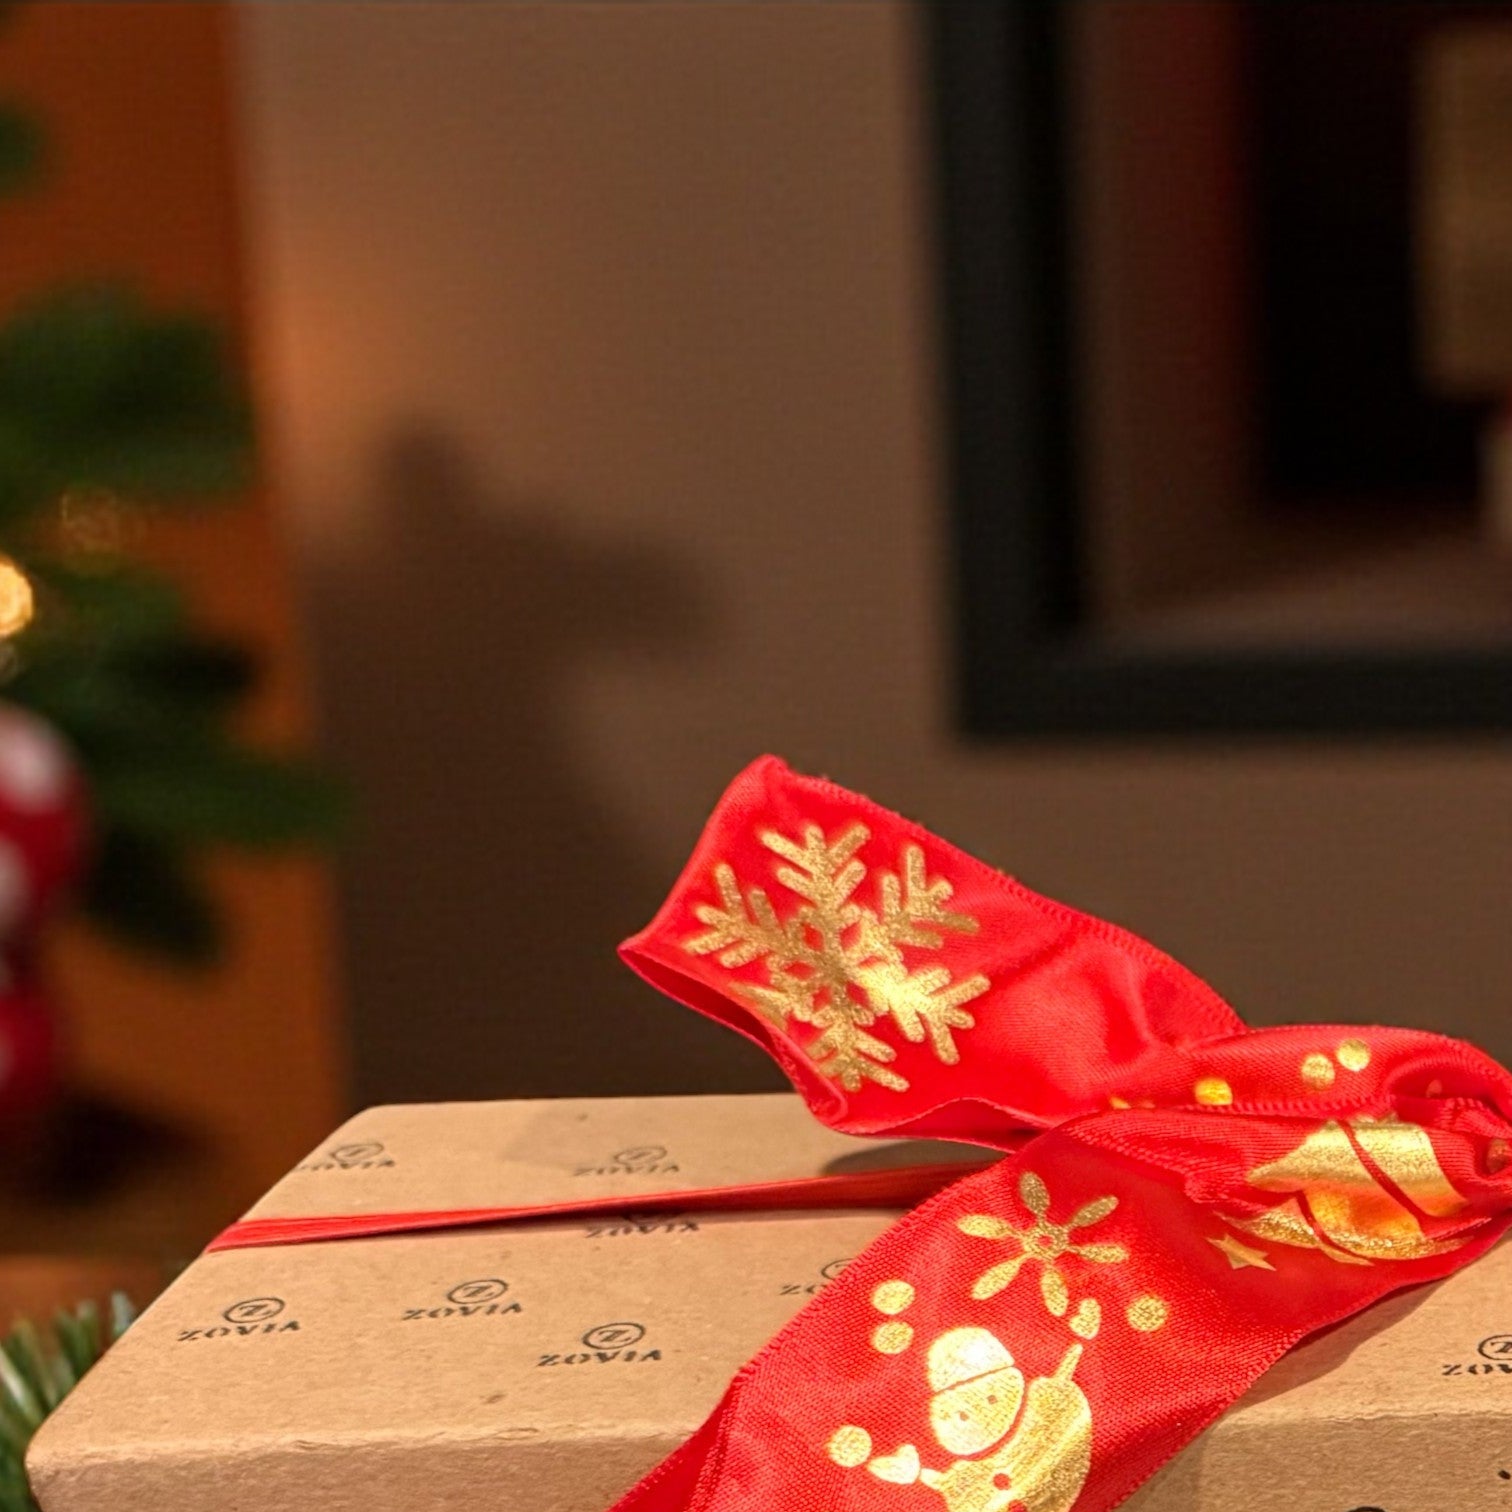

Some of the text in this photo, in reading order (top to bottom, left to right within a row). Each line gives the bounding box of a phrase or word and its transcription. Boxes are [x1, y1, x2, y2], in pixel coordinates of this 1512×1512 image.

[402, 1302, 524, 1322] ZOVIA
[177, 1320, 300, 1342] ZOVIA
[537, 1349, 663, 1367] ZOVIA
